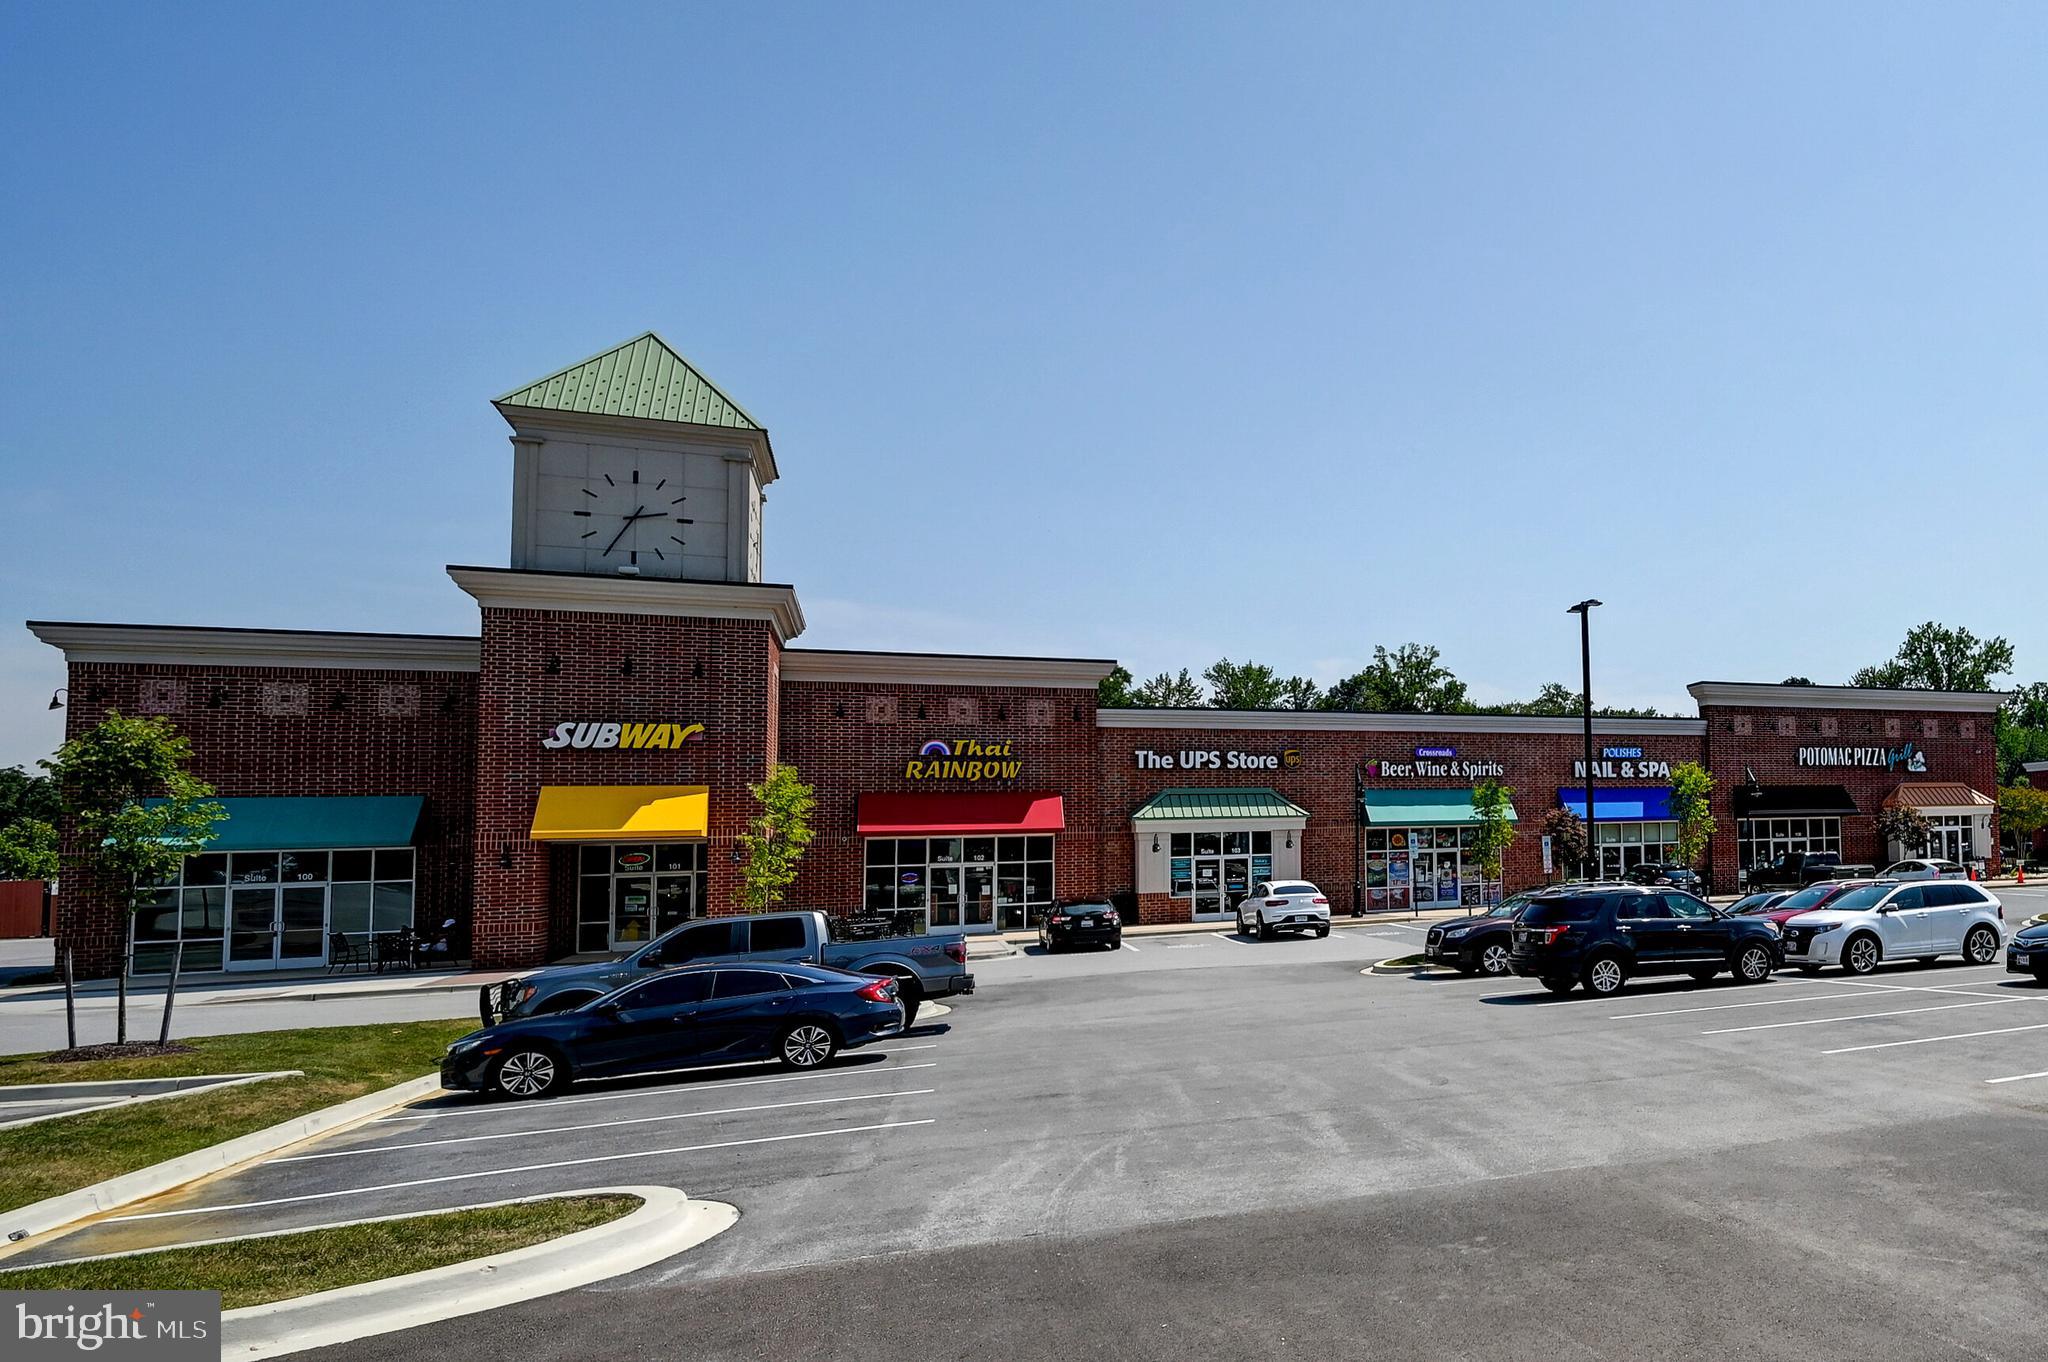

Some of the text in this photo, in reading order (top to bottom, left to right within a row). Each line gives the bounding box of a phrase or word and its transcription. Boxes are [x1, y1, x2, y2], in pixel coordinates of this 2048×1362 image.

[542, 722, 705, 750] SUBWAY
[953, 739, 1013, 756] Thai
[1418, 748, 1453, 757] Crossroads
[1603, 747, 1642, 758] POLISHES
[1135, 750, 1278, 769] The UPS Store
[1284, 754, 1300, 767] ups
[1799, 747, 1852, 766] POTOMAC
[1854, 747, 1887, 766] PIZZA
[905, 761, 1022, 781] RAINBOW
[1381, 760, 1504, 780] Beer, Wine & Spirits
[1574, 761, 1671, 778] NAIL & SPA
[244, 872, 313, 882] Suite 100
